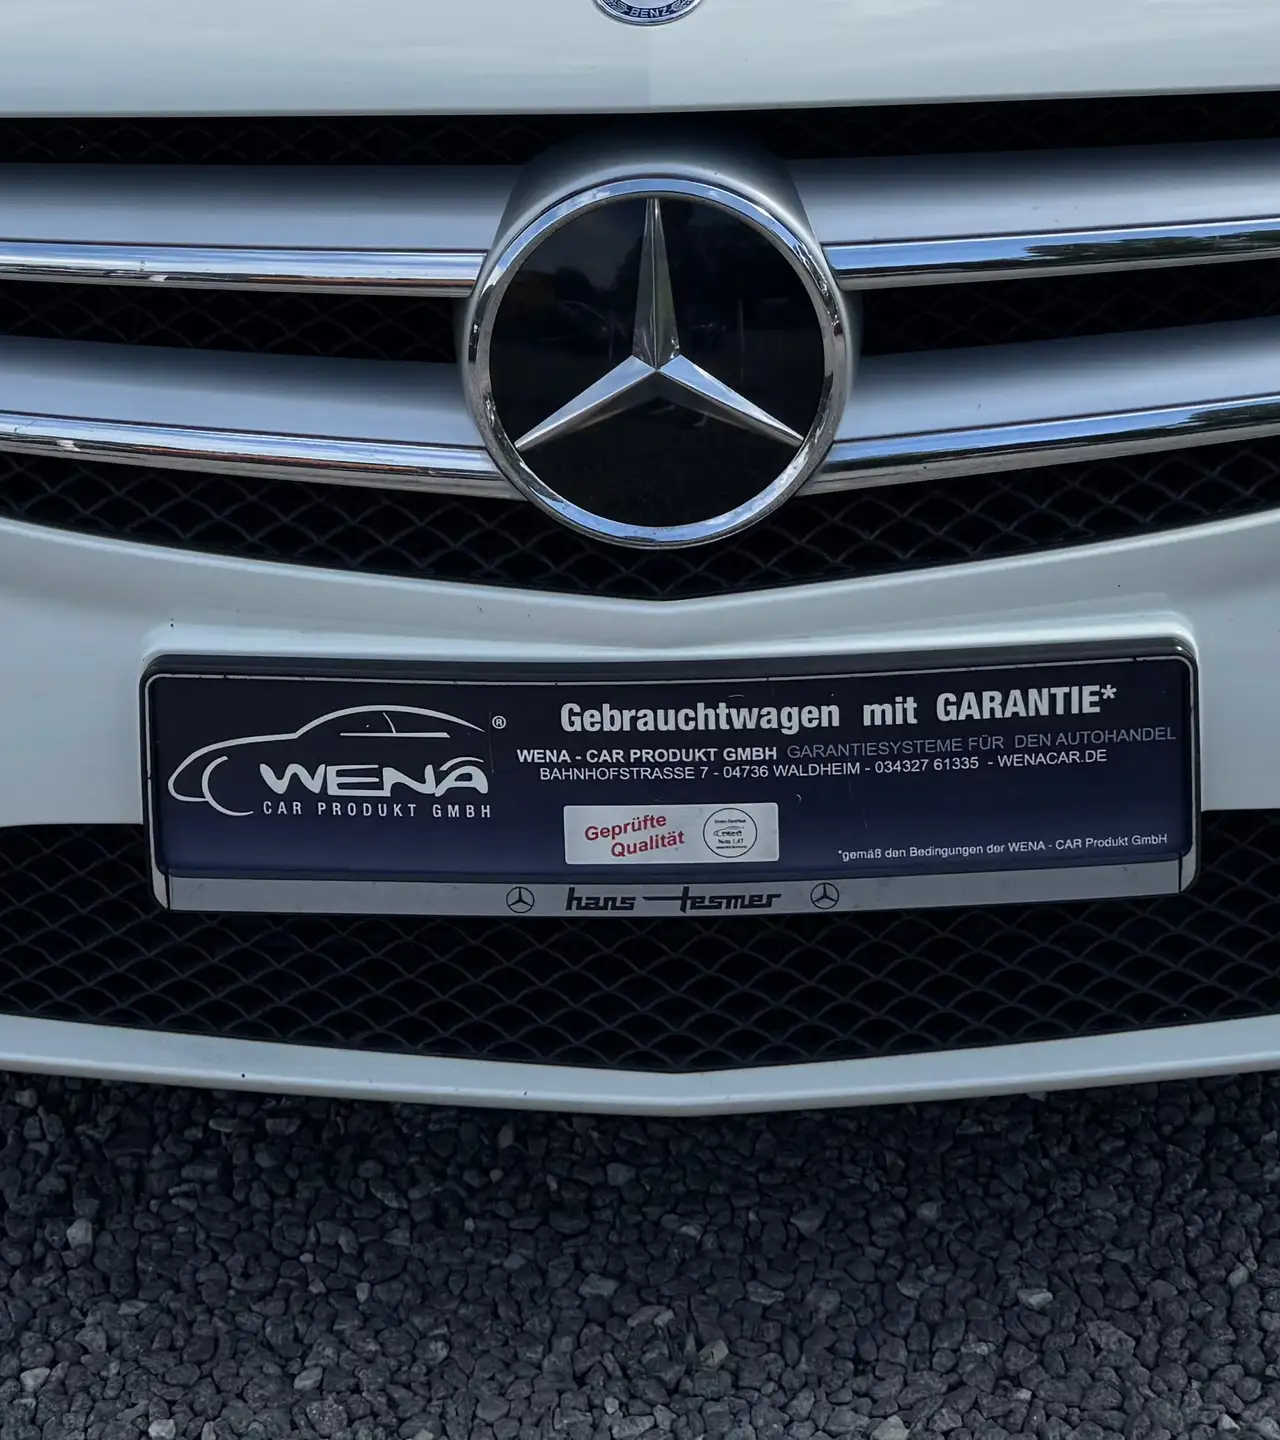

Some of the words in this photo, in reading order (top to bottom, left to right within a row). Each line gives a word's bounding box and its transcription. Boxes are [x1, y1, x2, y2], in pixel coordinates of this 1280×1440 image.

[630, 7, 670, 18] BENZ
[560, 702, 841, 735] Gebrauchtwagen
[863, 696, 918, 727] mit
[516, 748, 571, 764] WENA
[586, 749, 625, 763] CAR
[629, 748, 718, 763] PRODUKT
[723, 747, 777, 761] GMBH
[787, 738, 962, 759] GARANTIESYSTEME
[969, 734, 1004, 751] FÜR
[1015, 733, 1051, 749] DEN
[1055, 726, 1177, 746] AUTOHANDEL
[259, 757, 489, 798] WENA
[540, 766, 695, 781] BAHNHOFSTRASSE
[700, 766, 708, 779] 7
[723, 765, 768, 778] 04736
[773, 761, 860, 777] WALDHEIM
[875, 759, 928, 774] 034327
[933, 757, 979, 772] 61335
[997, 749, 1108, 768] WENACAR.DE
[263, 801, 302, 815] CAR
[318, 802, 417, 817] PRODUKT
[432, 804, 491, 818] GMBH
[584, 814, 667, 841] Geprüfte
[611, 830, 685, 858] Qualität
[885, 847, 907, 859] den
[910, 844, 983, 858] Bedingungen
[986, 842, 1005, 854] der
[1008, 841, 1046, 853] WENA
[1055, 839, 1082, 850] CAR
[1085, 836, 1129, 849] Produkt
[1131, 833, 1167, 846] GmbH
[565, 886, 637, 911] hans
